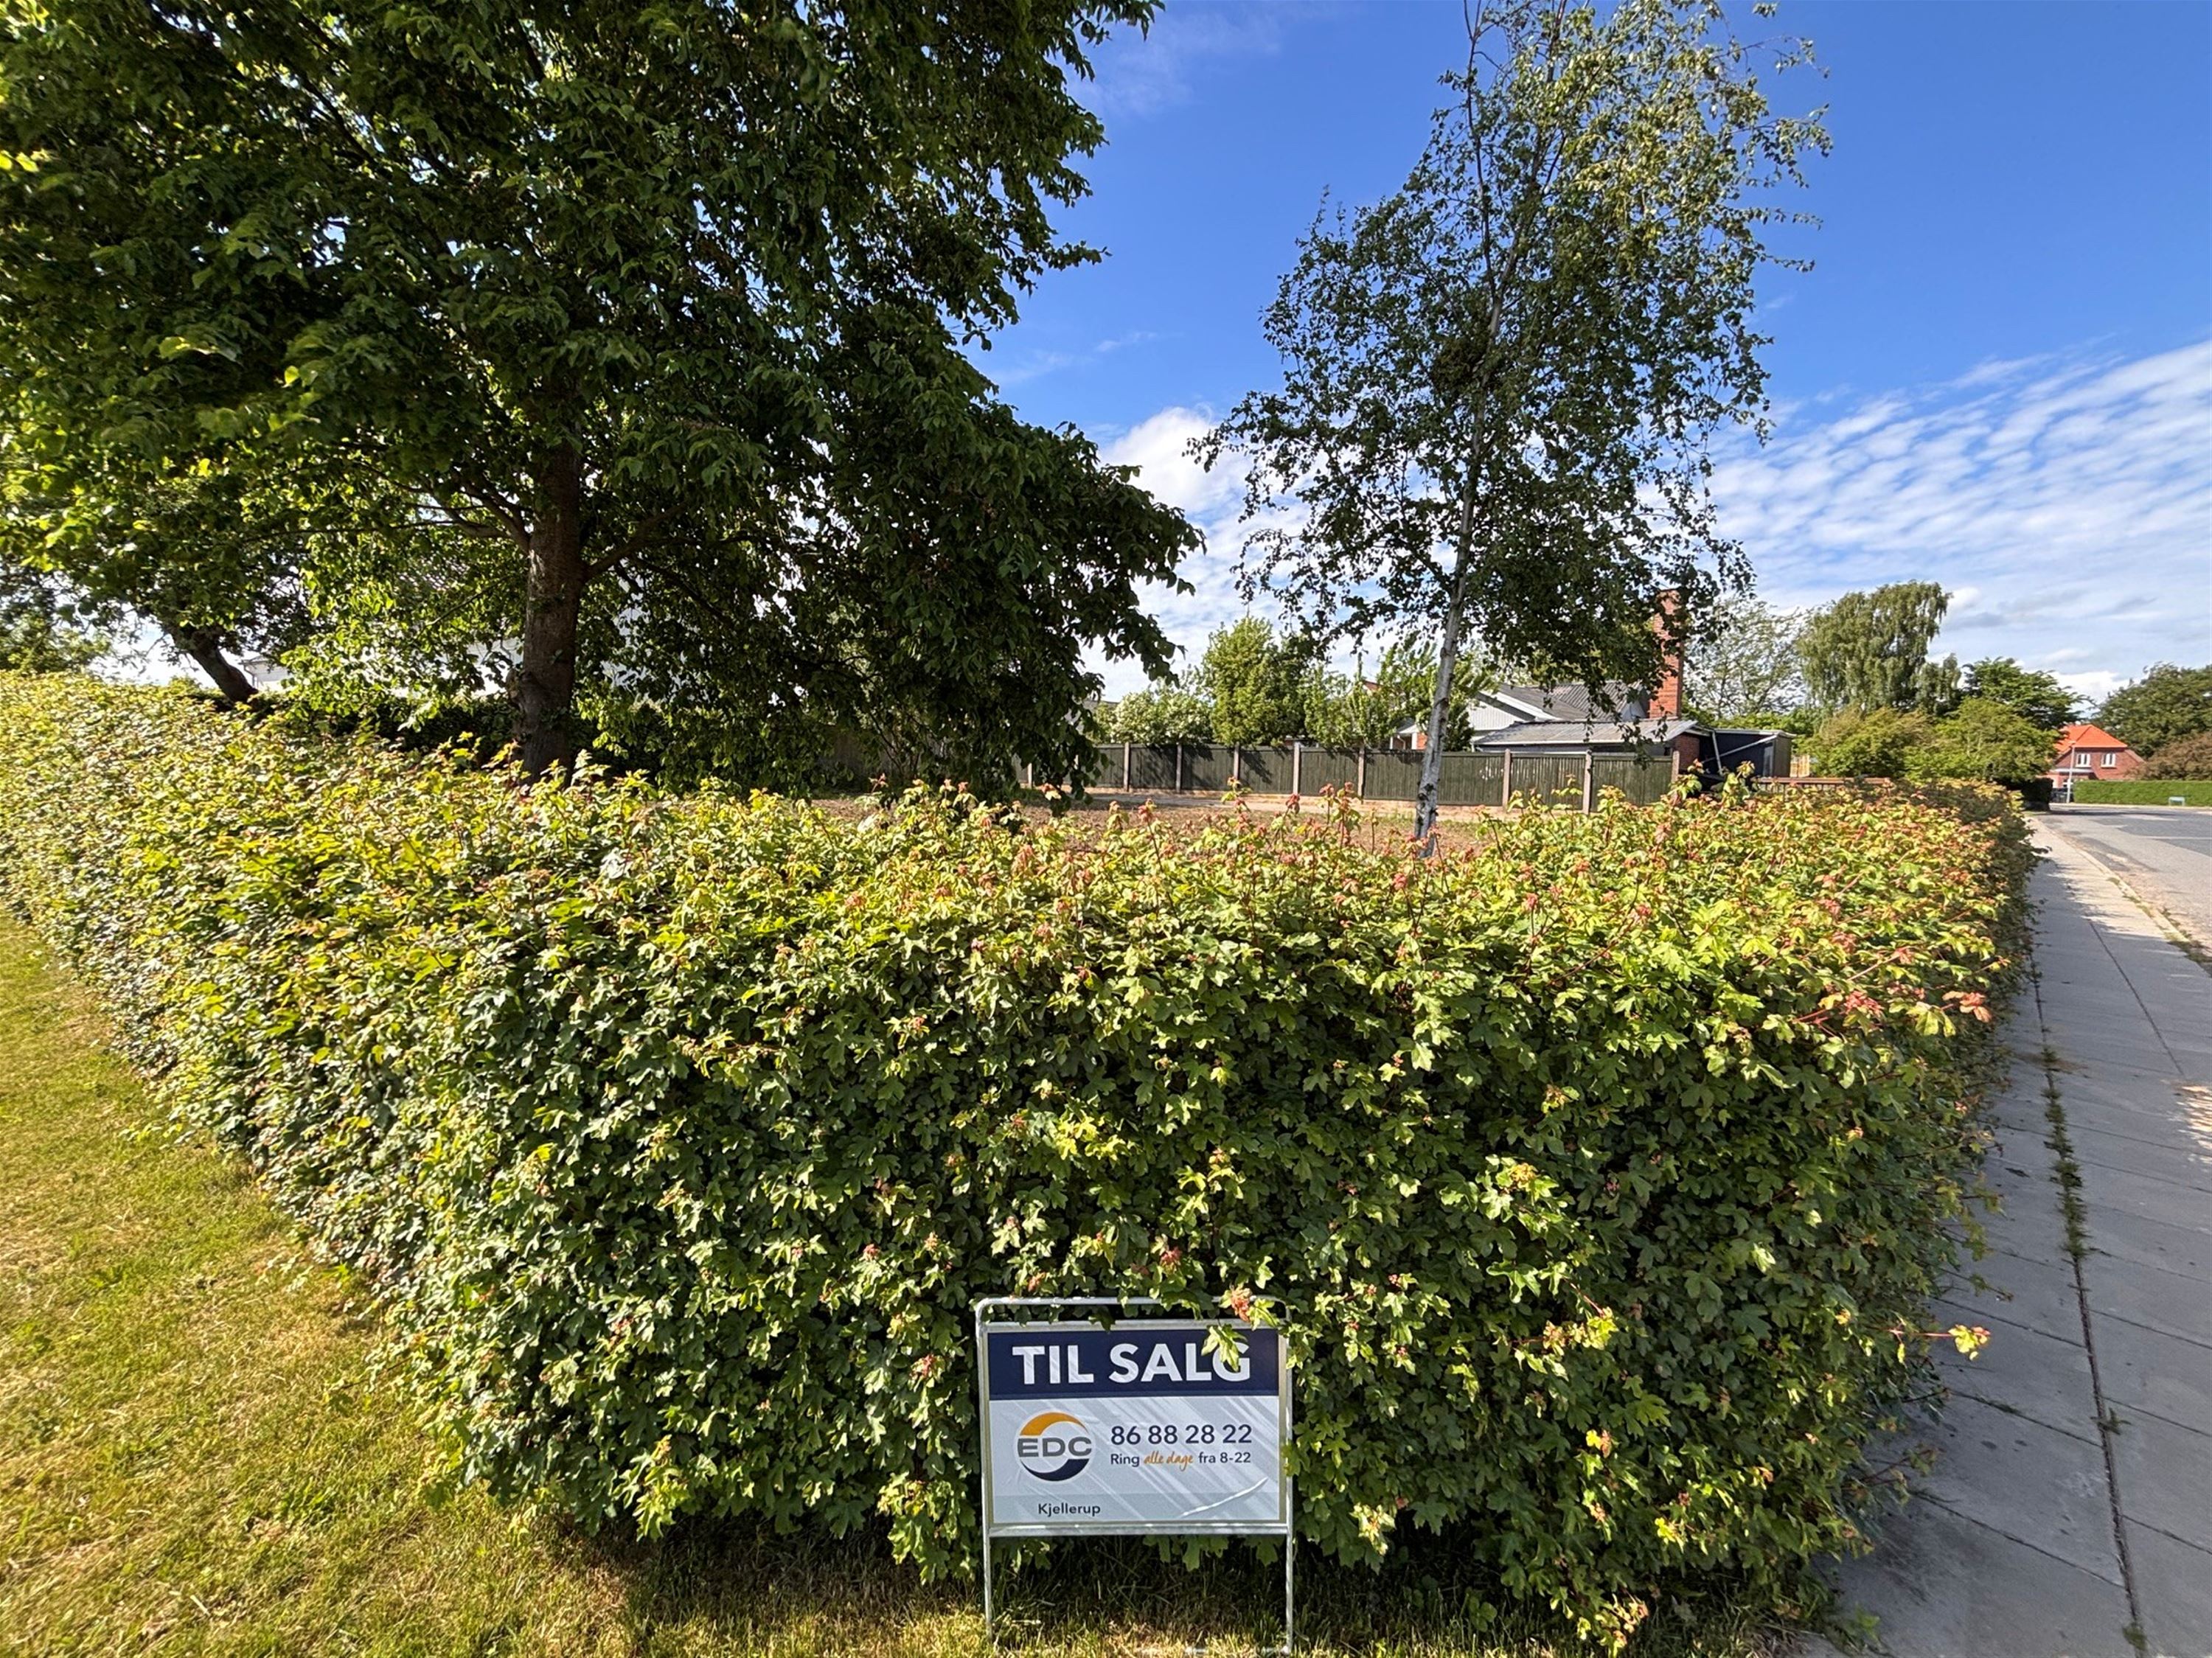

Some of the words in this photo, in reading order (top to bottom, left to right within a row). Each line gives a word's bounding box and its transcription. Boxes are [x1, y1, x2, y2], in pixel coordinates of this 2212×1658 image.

[1012, 1344, 1094, 1384] TIL
[1108, 1342, 1251, 1383] SALG
[1110, 1425, 1141, 1445] 86
[1148, 1425, 1178, 1444] 88
[1185, 1424, 1214, 1444] 28
[1222, 1424, 1252, 1443] 22
[1017, 1436, 1092, 1458] EDC
[1110, 1453, 1140, 1467] Ring
[1144, 1451, 1164, 1465] alle
[1166, 1452, 1194, 1471] dage
[1198, 1453, 1216, 1463] fra
[1220, 1452, 1251, 1463] 8-22
[1037, 1502, 1101, 1516] Kjellerup
